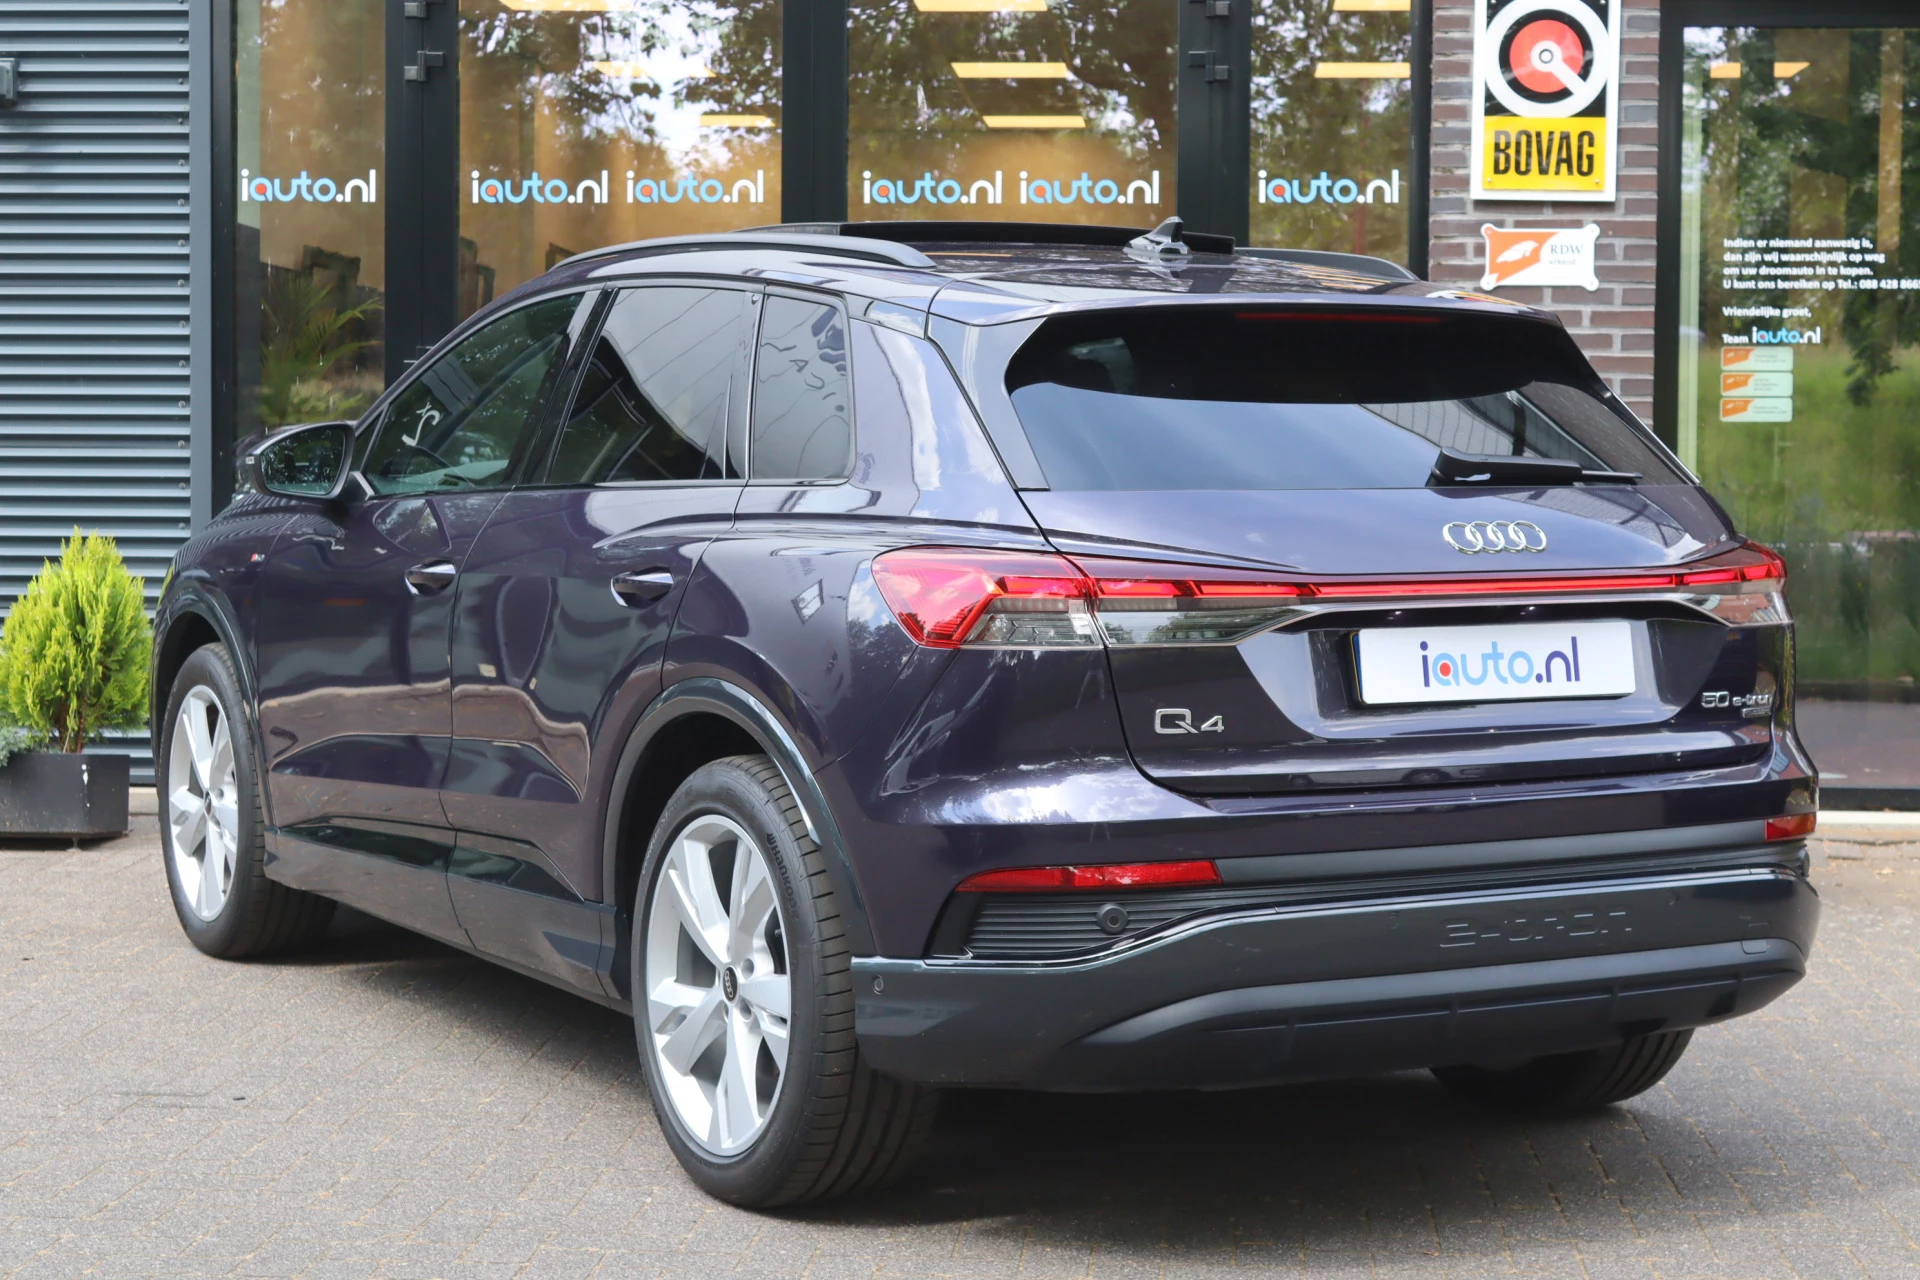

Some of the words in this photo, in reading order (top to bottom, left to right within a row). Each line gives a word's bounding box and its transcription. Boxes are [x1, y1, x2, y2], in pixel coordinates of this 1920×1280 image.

[1493, 130, 1595, 177] BOVAG
[240, 168, 376, 202] iauto.nl
[471, 169, 608, 204] iauto.nl
[626, 169, 764, 204] iauto.nl
[862, 169, 1002, 204] iauto.nl
[1019, 169, 1160, 204] iauto.nl
[1257, 168, 1400, 204] iauto.nl
[1550, 244, 1583, 255] RDW
[1723, 238, 1755, 248] Indien
[1756, 240, 1768, 248] er
[1769, 237, 1813, 248] niemand
[1814, 238, 1860, 250] aanwezig
[1861, 237, 1874, 249] is,
[1723, 251, 1743, 261] dan
[1744, 251, 1762, 264] zijn
[1763, 251, 1779, 264] wij
[1780, 251, 1848, 264] waarschijnlijk
[1848, 253, 1863, 264] op
[1864, 253, 1886, 264] weg
[1723, 267, 1740, 275] om
[1741, 267, 1757, 275] uw
[1758, 265, 1814, 275] droomauto
[1815, 265, 1826, 275] in
[1827, 266, 1838, 275] te
[1840, 265, 1874, 277] kopen.
[1722, 279, 1732, 289] U
[1733, 279, 1756, 289] kunt
[1757, 281, 1776, 289] ons
[1777, 279, 1820, 289] bereiken
[1821, 280, 1836, 291] op
[1837, 279, 1858, 289] Tel.:
[1859, 279, 1879, 289] 088
[1879, 279, 1899, 289] 428
[1722, 306, 1781, 318] Vriendelijke
[1782, 307, 1812, 318] groet,
[1722, 333, 1749, 344] Team
[1751, 326, 1821, 344] iauto.nl
[1420, 636, 1580, 687] iauto.nl
[1701, 691, 1729, 708] 50
[1155, 708, 1225, 734] Q4
